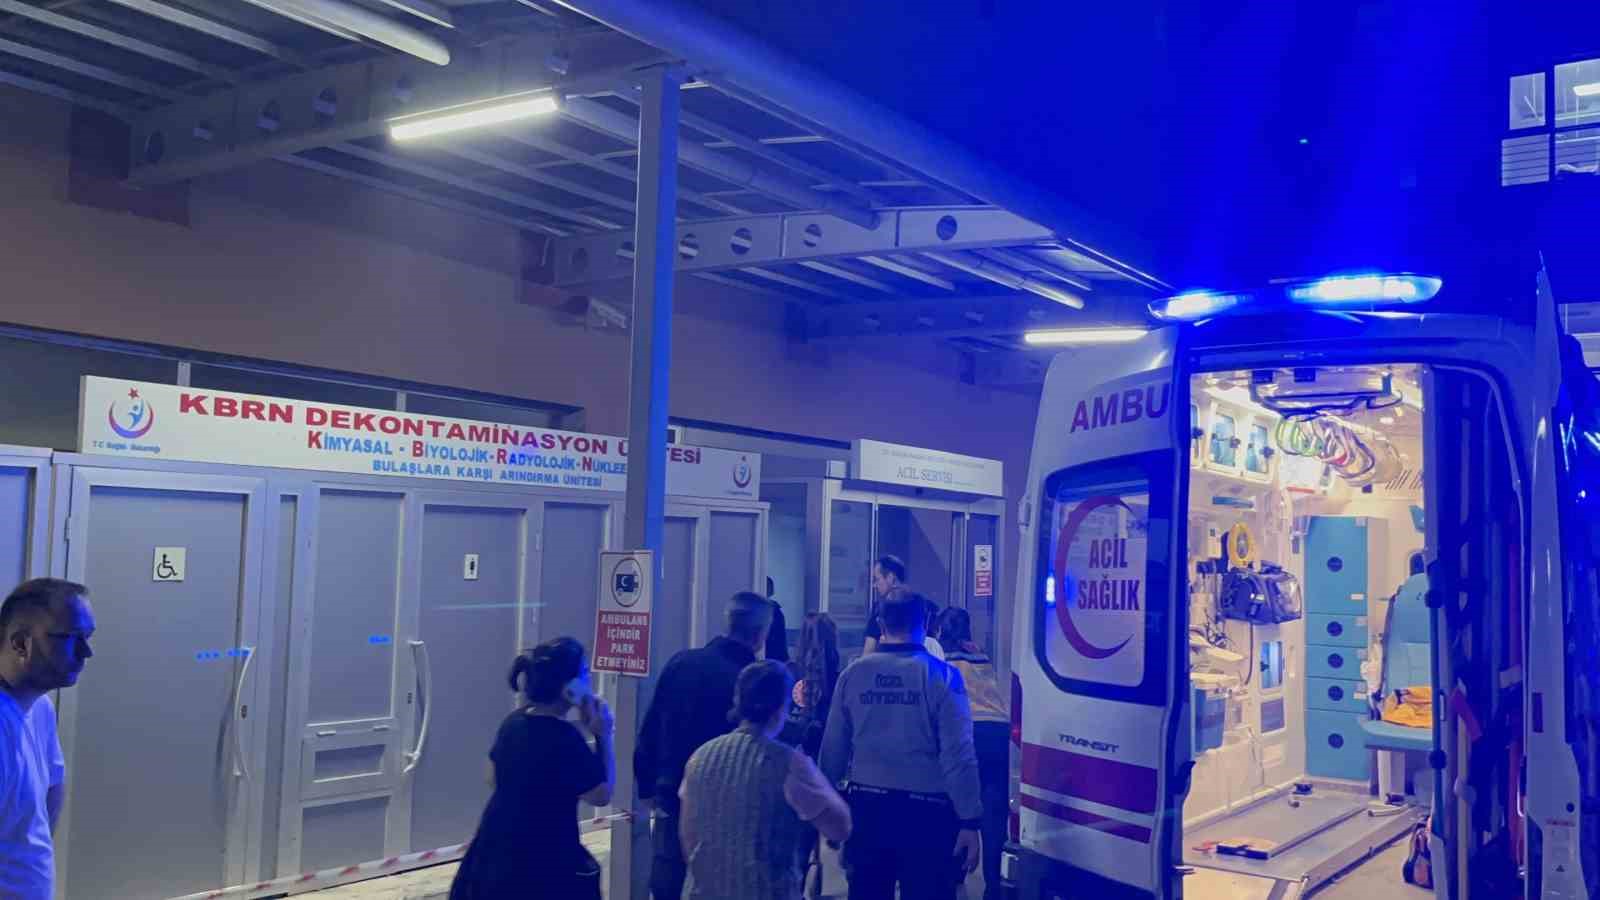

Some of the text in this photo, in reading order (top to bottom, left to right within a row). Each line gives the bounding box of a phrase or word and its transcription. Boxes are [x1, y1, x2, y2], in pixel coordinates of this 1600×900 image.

[179, 393, 294, 424] KBRN
[305, 407, 608, 456] DEKONTAMİNASYON
[1070, 383, 1170, 433] AMBU
[307, 430, 393, 455] KİMYASAL
[1089, 533, 1128, 569] ACİL
[1078, 573, 1141, 611] SAĞLIK
[610, 643, 636, 655] PARK
